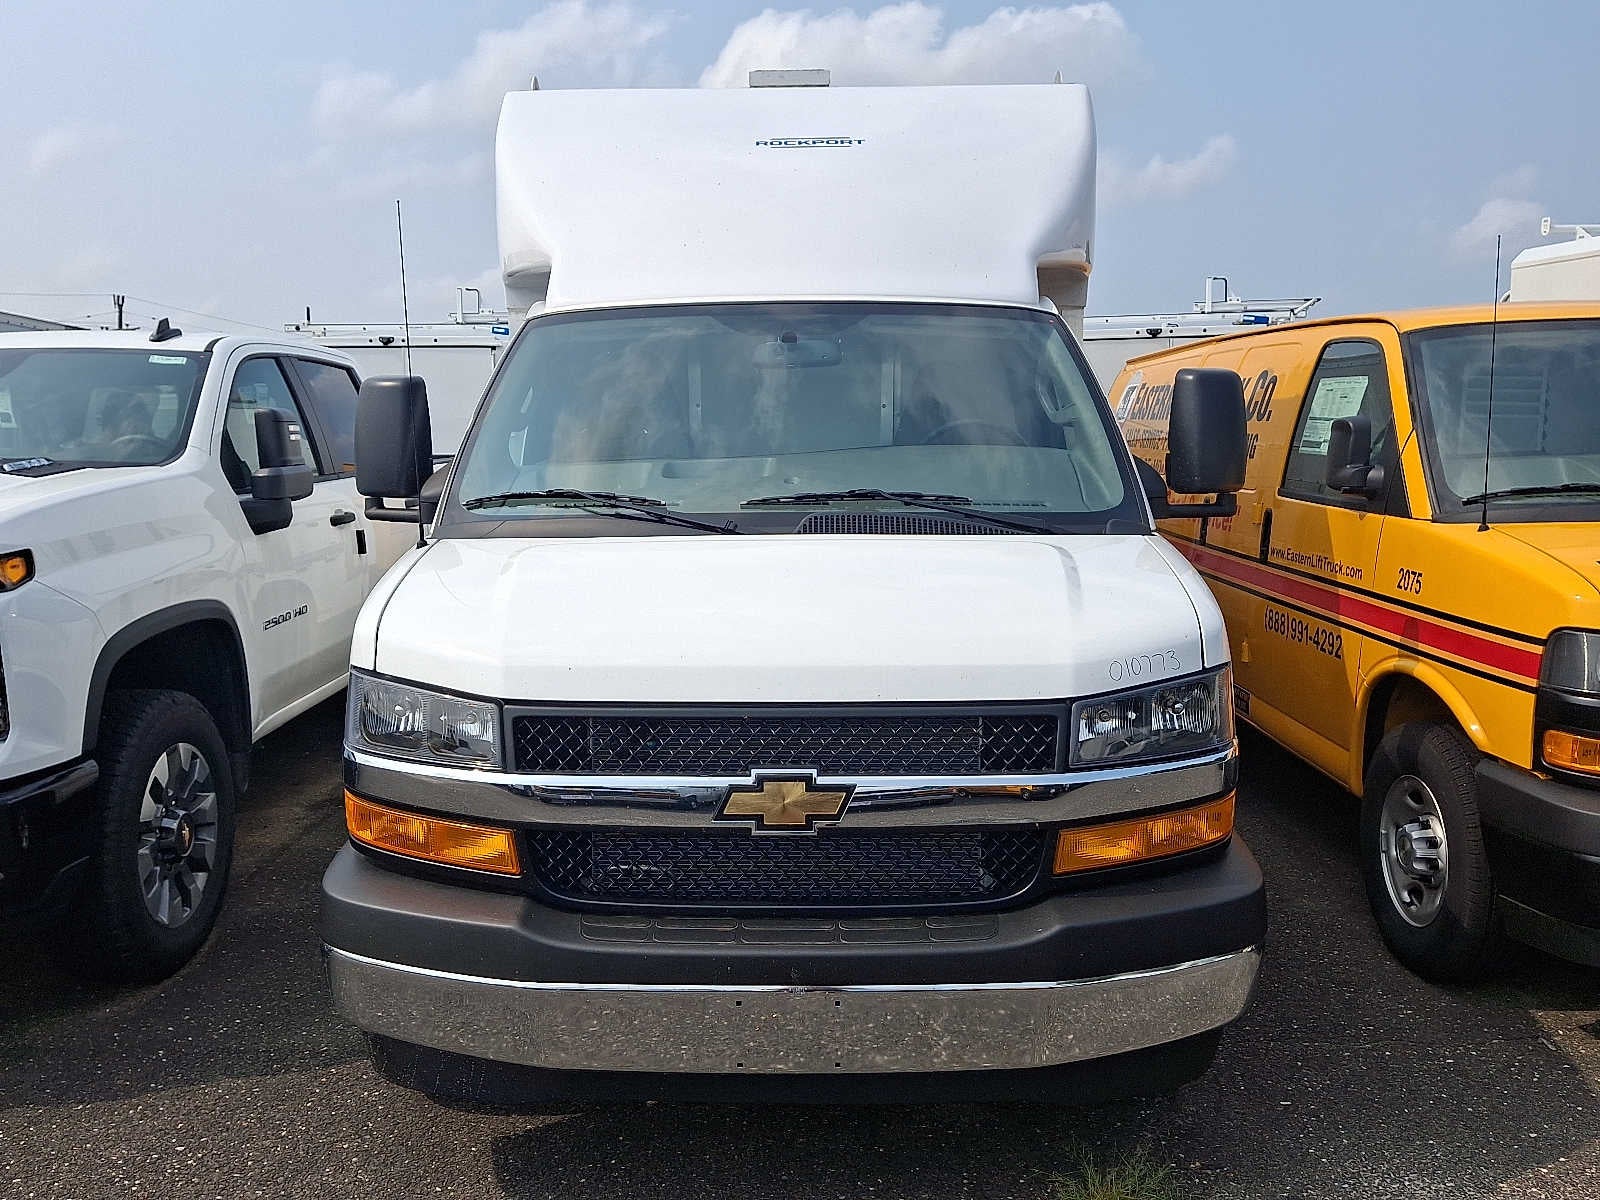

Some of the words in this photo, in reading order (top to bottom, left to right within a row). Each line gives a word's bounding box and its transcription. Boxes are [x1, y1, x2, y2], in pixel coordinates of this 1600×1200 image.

[1246, 370, 1278, 422] CO.
[1270, 547, 1363, 580] www.EasternLiftTruck.com
[1396, 567, 1423, 595] 2075
[263, 611, 292, 631] 2500
[293, 604, 308, 618] HD
[1108, 649, 1181, 682] 010773
